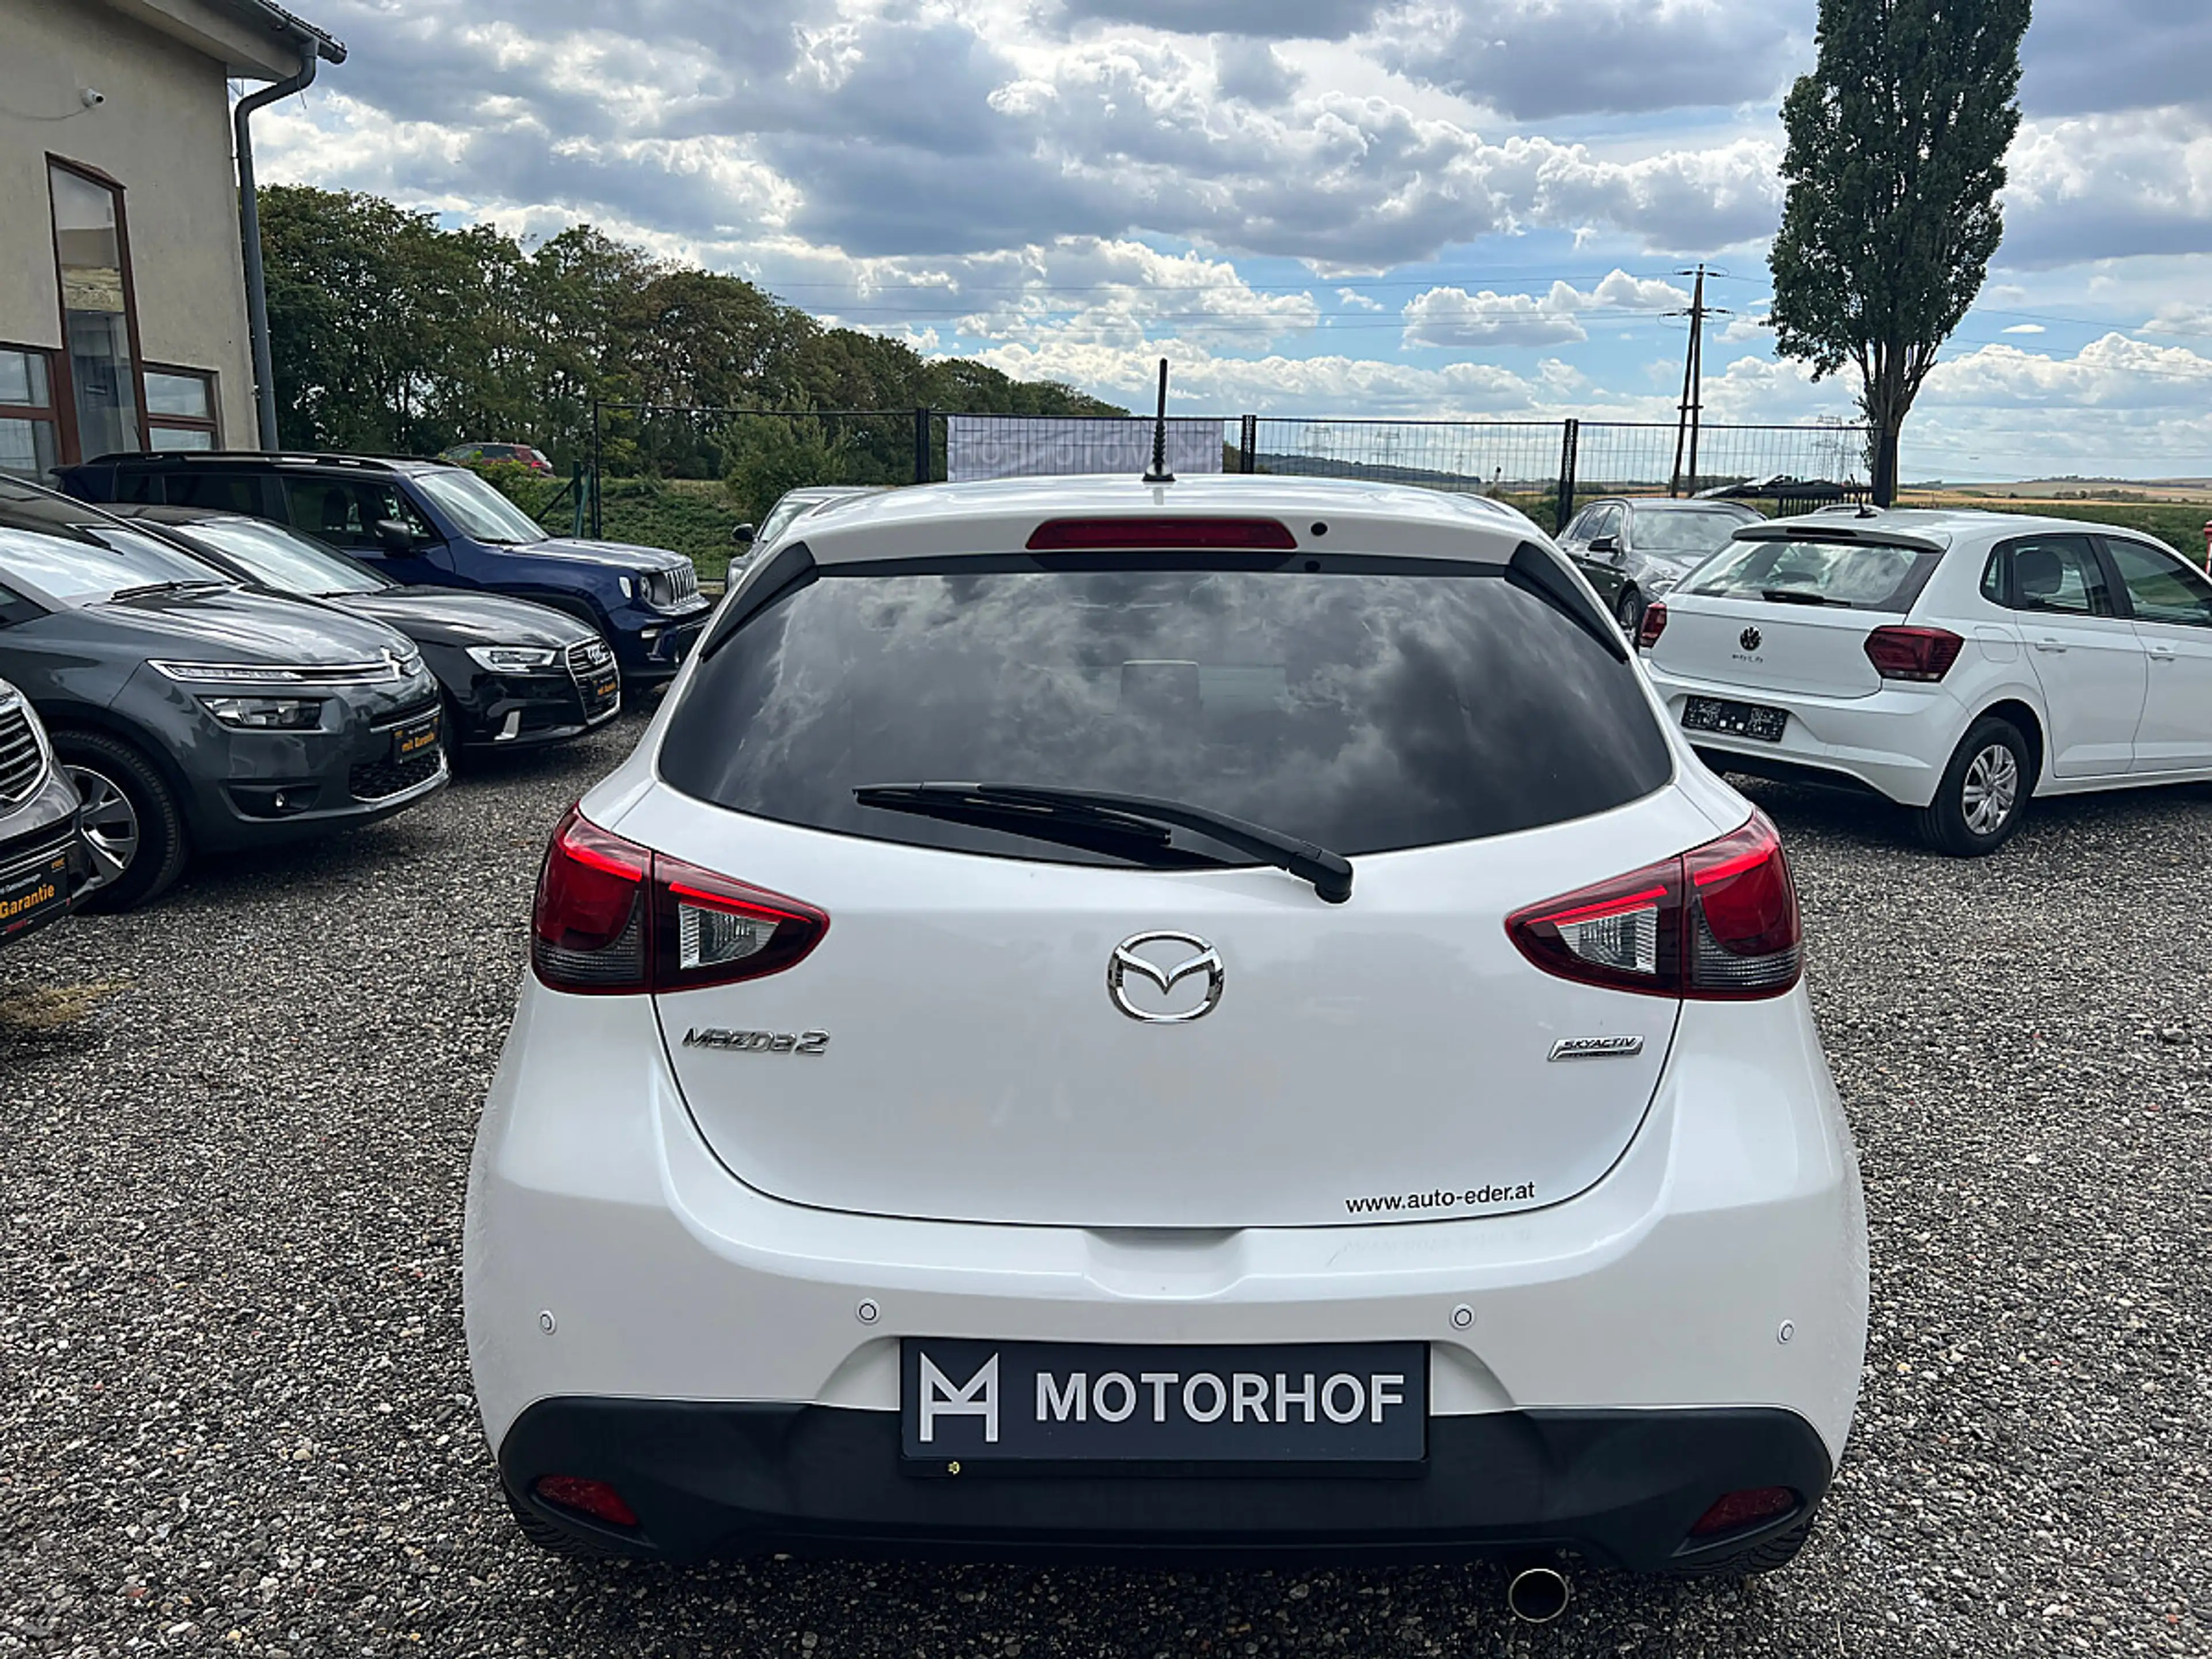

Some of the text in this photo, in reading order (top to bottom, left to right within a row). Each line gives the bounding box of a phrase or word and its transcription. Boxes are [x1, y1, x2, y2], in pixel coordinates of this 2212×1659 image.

[0, 883, 55, 918] Garantie
[1563, 1037, 1637, 1050] SKYACTIV
[1346, 1181, 1535, 1213] www.auto-eder.at
[1037, 1372, 1404, 1423] MOTORHOF
